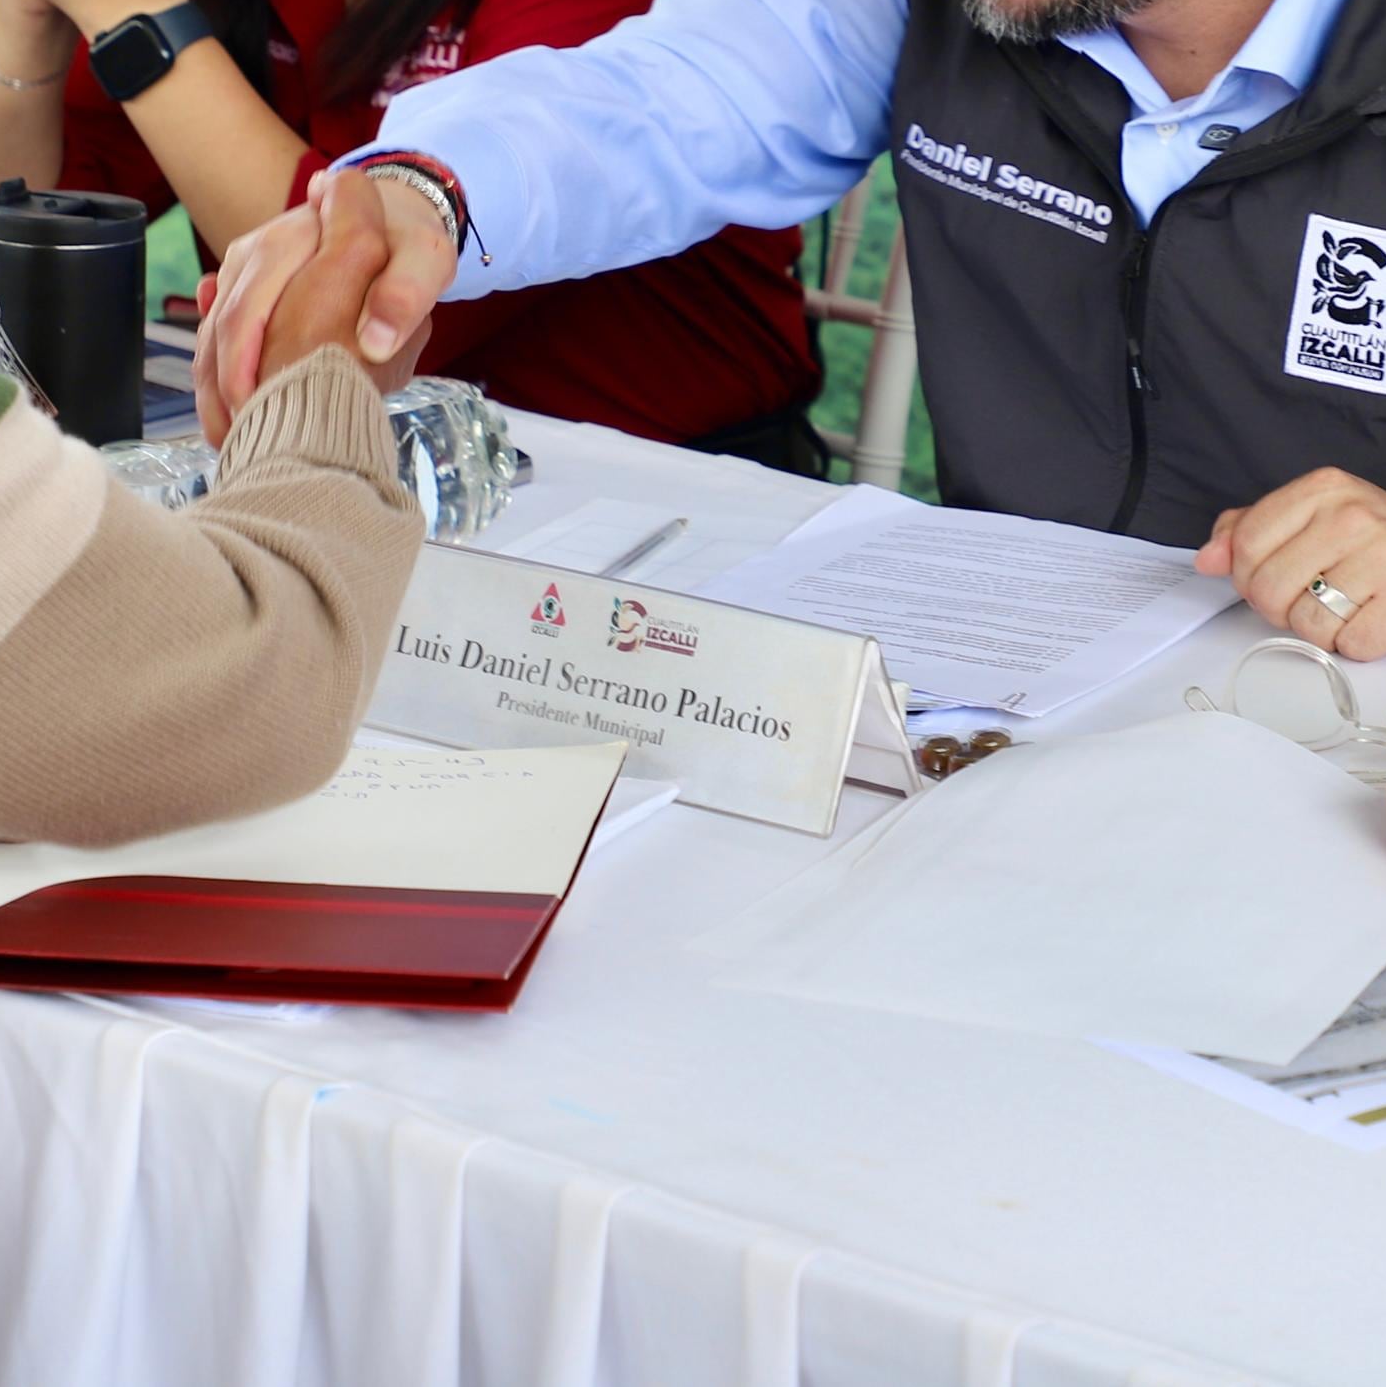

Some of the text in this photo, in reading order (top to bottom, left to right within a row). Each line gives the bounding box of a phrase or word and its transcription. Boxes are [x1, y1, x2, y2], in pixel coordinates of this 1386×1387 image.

[906, 123, 1113, 225] Daniel Serrano
[1300, 336, 1386, 368] IZCALLI
[645, 626, 699, 649] IZCALLI
[394, 624, 793, 743] Luis Daniel Serrano Palacios
[496, 690, 665, 746] Presidente Municipal
